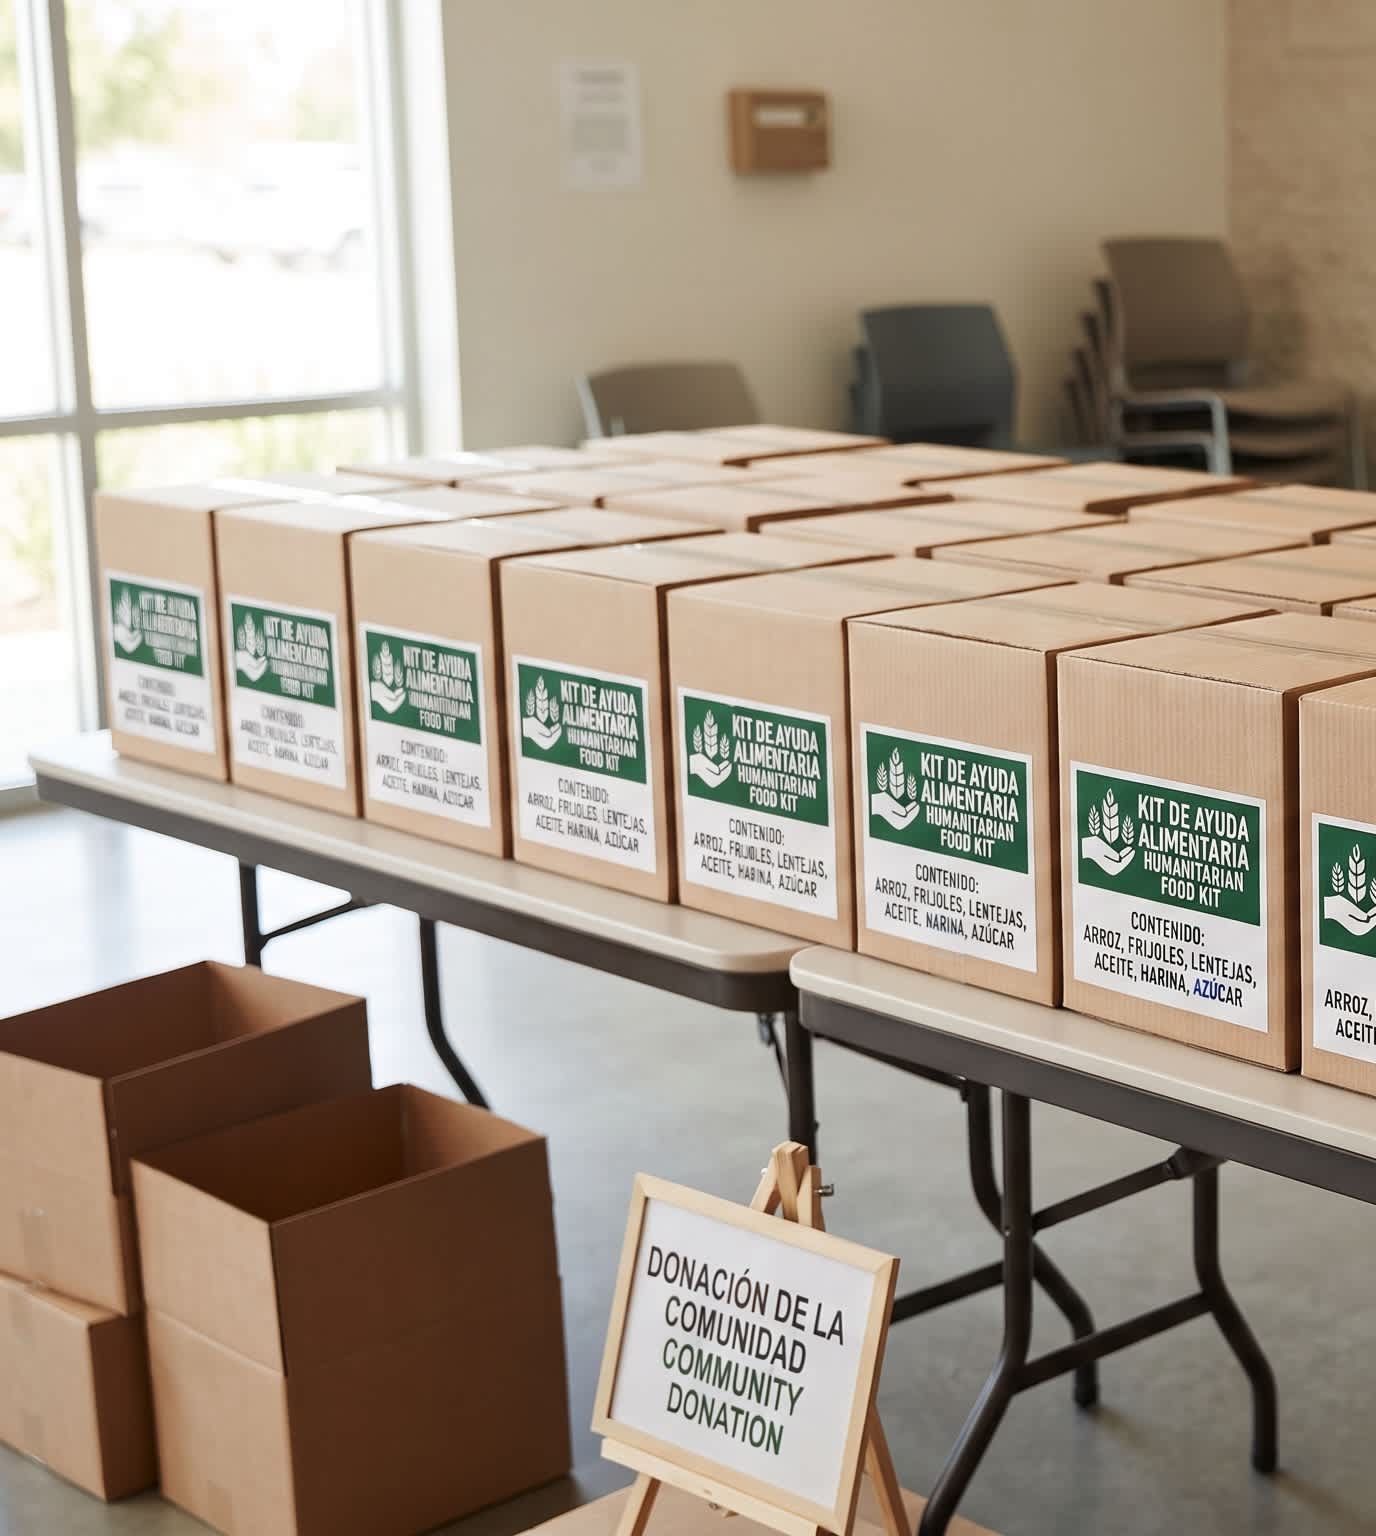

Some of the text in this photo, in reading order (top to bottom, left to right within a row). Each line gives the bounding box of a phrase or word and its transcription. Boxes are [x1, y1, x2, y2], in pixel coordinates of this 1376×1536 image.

[421, 649, 436, 673] DE
[732, 714, 818, 754] KIT DE AYUDA
[733, 740, 820, 779] ALIMENTARIA
[920, 752, 1018, 796] KIT DE AYUDA
[737, 764, 816, 799] HUMANITARIAN
[749, 785, 798, 812] FOOD KIT
[921, 779, 1018, 822] ALIMENTARIA
[729, 819, 784, 845] CONTENIDO:
[926, 805, 1013, 842] HUMANITARIAN
[1138, 794, 1249, 841] KIT DE AYUDA
[694, 832, 726, 855] ARROZ,
[778, 852, 827, 879] LENTEJAS,
[940, 828, 994, 858] FOOD KIT
[1138, 823, 1249, 869] ALIMENTARIA
[701, 855, 735, 879] ACEITE,
[779, 874, 816, 898] AZÚCAR
[915, 863, 979, 893] CONTENIDO:
[1144, 851, 1244, 891] HUMANITARIAN
[913, 886, 966, 917] FRIJOLES,
[968, 899, 1027, 932] LENTEJAS,
[1161, 876, 1222, 907] FOOD KIT
[971, 922, 1015, 950] AZÚCAR
[1131, 911, 1205, 946] CONTENIDO:
[1083, 924, 1257, 988] ARROZ, FRIJOLES, LENTEJAS,
[1094, 951, 1243, 1007] ACEITE, HARINA, AZÚCAR
[1324, 988, 1373, 1021] ARROZ,
[647, 1245, 845, 1345] DONACIÓN DE LA
[664, 1295, 807, 1374] COMUNIDAD
[662, 1337, 805, 1417] COMMUNITY
[666, 1382, 785, 1456] DONATION
